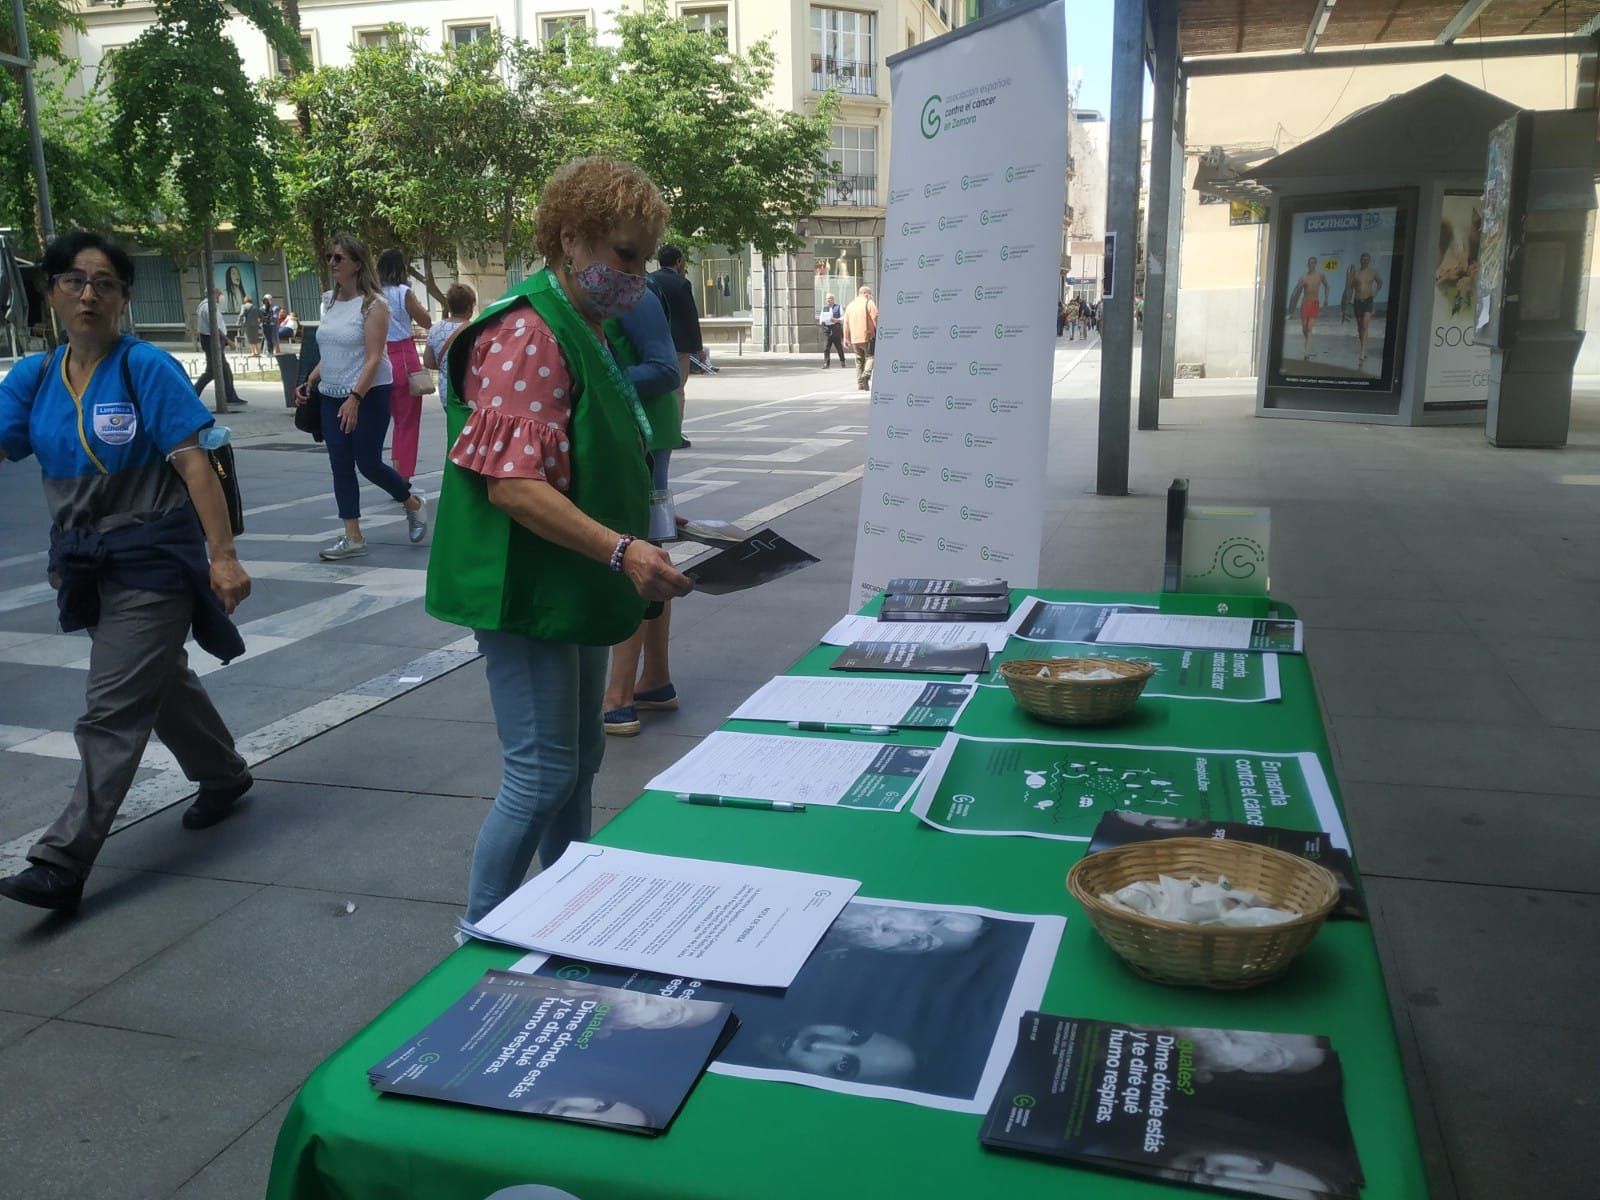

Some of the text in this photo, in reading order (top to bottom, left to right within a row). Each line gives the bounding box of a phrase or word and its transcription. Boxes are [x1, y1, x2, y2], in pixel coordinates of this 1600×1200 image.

[944, 103, 965, 118] contra
[965, 100, 972, 112] el
[951, 114, 977, 129] Zamora
[1307, 216, 1359, 230] DECATHLON
[1235, 758, 1257, 787] contra
[1240, 787, 1263, 797] el
[1261, 760, 1292, 806] En marcha
[516, 998, 576, 1067] y te diré qué
[524, 997, 560, 1031] humo
[483, 1031, 530, 1075] respiras.
[508, 1000, 598, 1099] Dime dónde estás
[1096, 1028, 1129, 1124] humo respiras.
[1121, 1031, 1150, 1114] y te diré qué
[1143, 1035, 1175, 1153] Dime dónde estás
